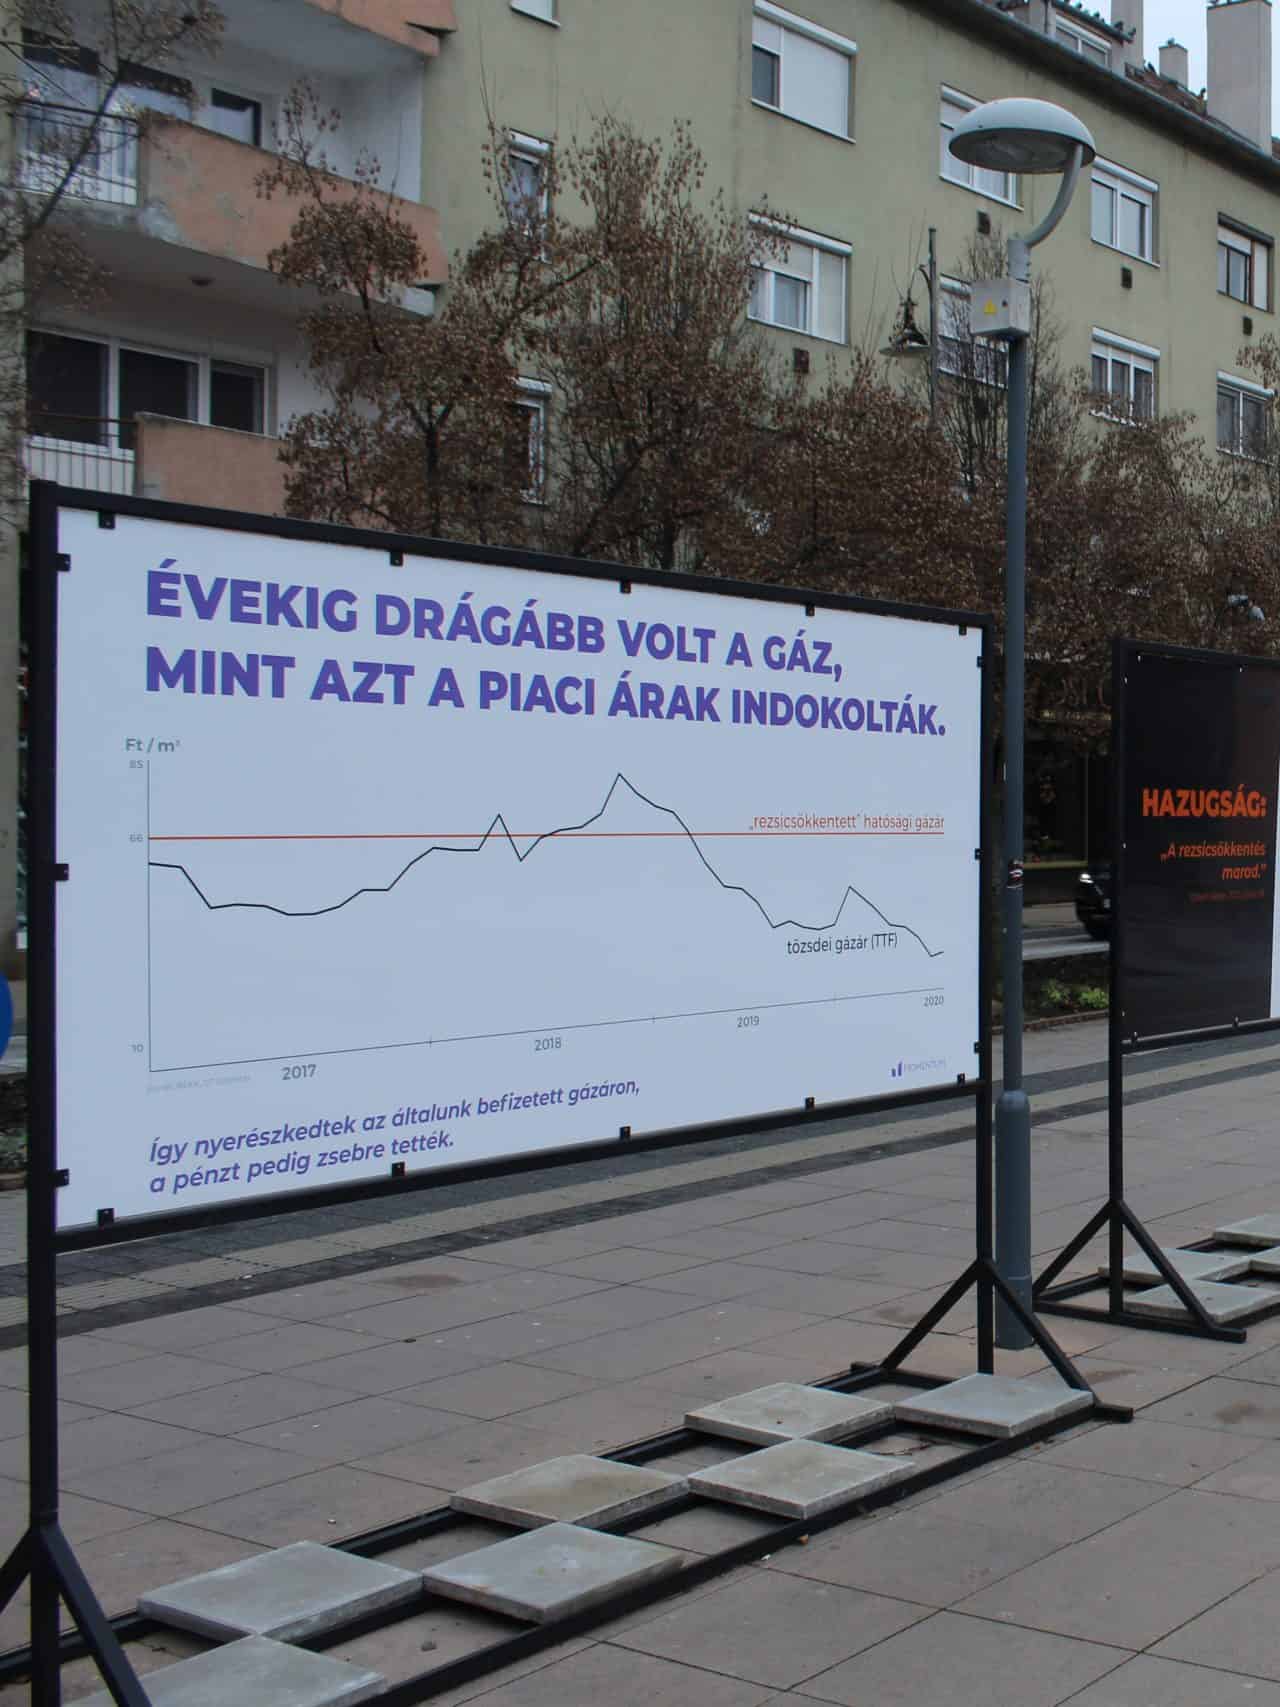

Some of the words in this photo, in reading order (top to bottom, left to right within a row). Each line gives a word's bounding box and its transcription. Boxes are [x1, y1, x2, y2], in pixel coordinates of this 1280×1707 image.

[147, 558, 358, 632] ÉVEKIG
[375, 592, 605, 653] DRÁGÁBB
[617, 619, 716, 664] VOLT
[725, 632, 752, 668] A
[763, 629, 842, 682] GÁZ,
[146, 646, 295, 698] MINT
[310, 659, 416, 705] AZT
[428, 667, 465, 708] A
[479, 670, 595, 716] PIACI
[608, 670, 720, 722] ÁRAK
[731, 688, 947, 736] INDOKOLTÁK.
[125, 738, 143, 752] Ft
[146, 737, 154, 753] /
[1141, 784, 1267, 818] HAZUGSÁG:
[863, 813, 912, 832] hatósági
[915, 814, 945, 832] gázár
[1160, 842, 1176, 864] „A
[1179, 840, 1265, 857] rezsicsökkentés
[787, 936, 832, 955] tőzsdei
[835, 934, 867, 954] gázár
[871, 932, 898, 950] (TTF)
[924, 994, 944, 1008] 2020
[736, 1015, 760, 1028] 2019
[534, 1035, 562, 1052] 2018
[282, 1063, 317, 1081] 2017
[149, 1134, 189, 1165] Így
[194, 1114, 356, 1158] nyerészkedtek
[362, 1113, 386, 1132] az
[391, 1098, 472, 1128] általunk
[477, 1086, 564, 1116] befizetett
[568, 1078, 640, 1106] gázáron,
[149, 1176, 166, 1195] a
[173, 1162, 240, 1195] pénzt
[246, 1150, 312, 1181] pedig
[317, 1139, 385, 1168] zsebre
[390, 1130, 455, 1156] tették.
